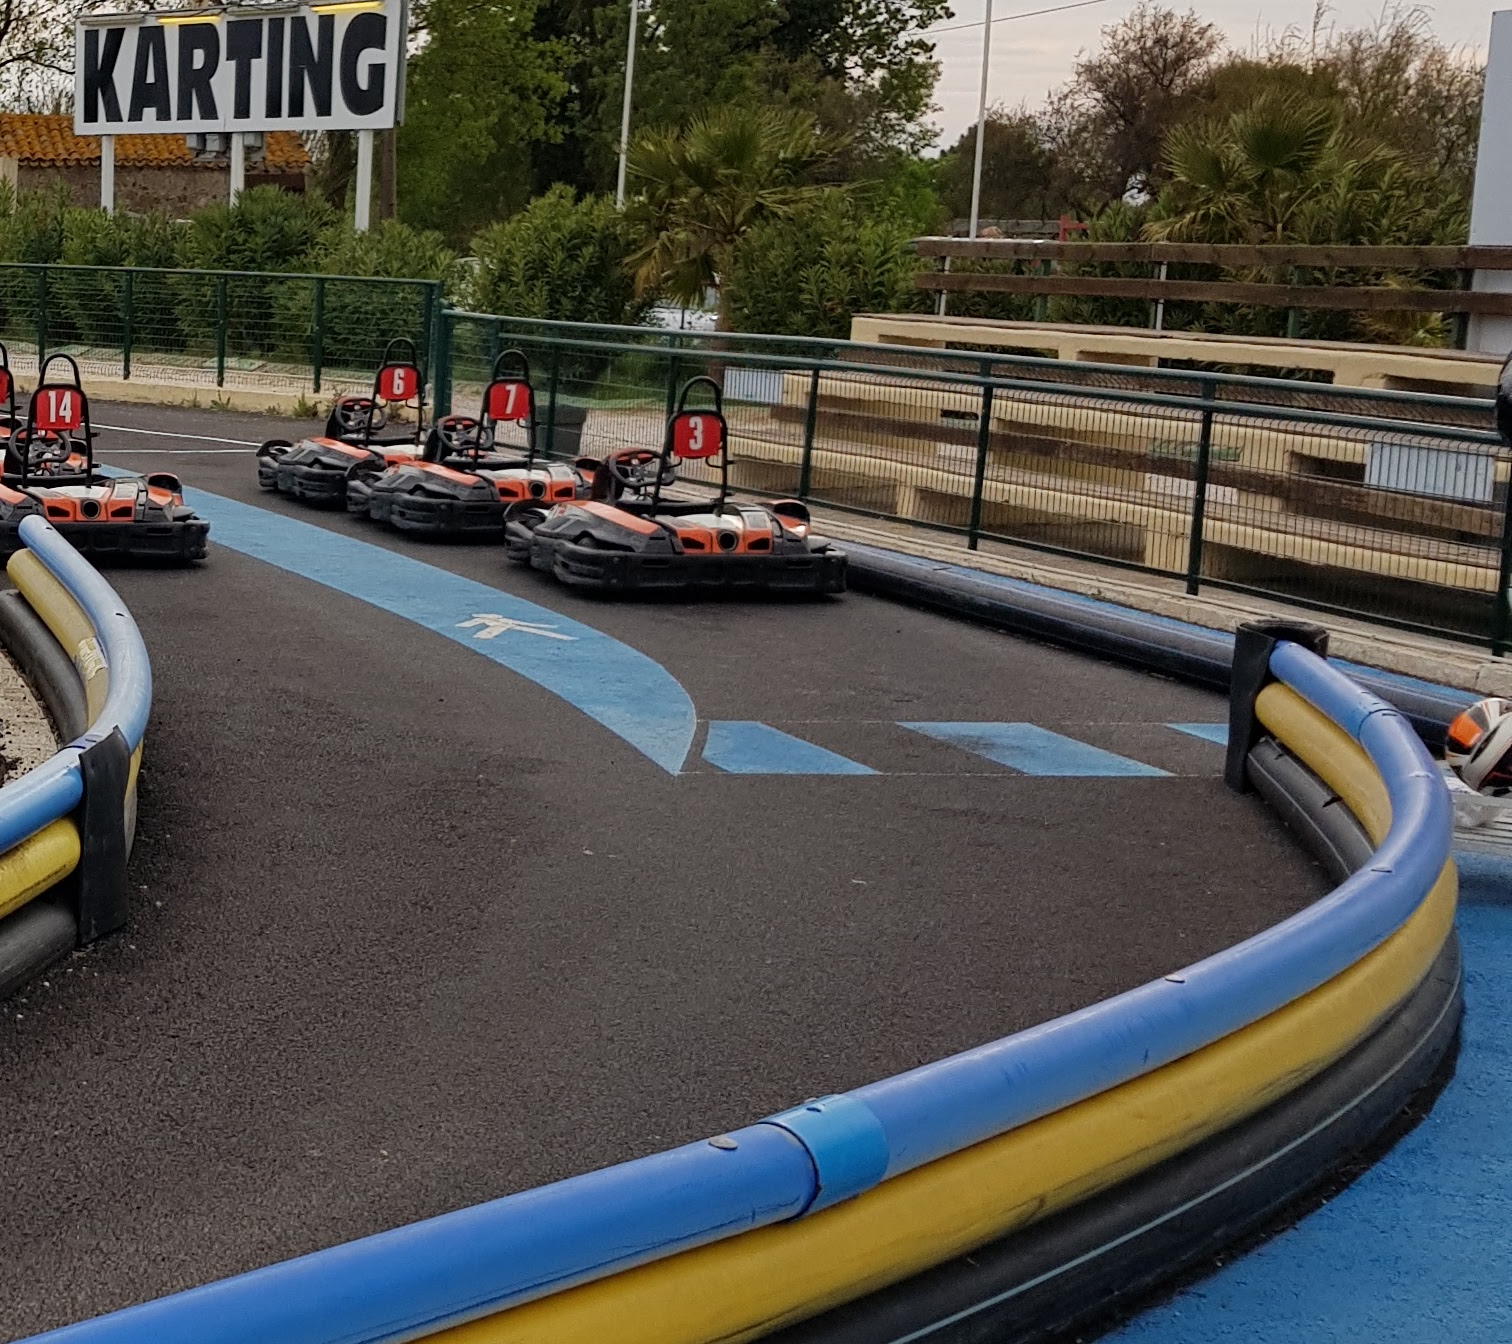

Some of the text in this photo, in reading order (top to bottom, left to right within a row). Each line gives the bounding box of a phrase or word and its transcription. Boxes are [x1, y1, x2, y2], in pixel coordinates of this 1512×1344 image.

[83, 11, 388, 123] KARTING
[392, 367, 405, 395] 6
[48, 390, 72, 423] 14
[505, 384, 517, 415] 7
[688, 415, 703, 451] 3
